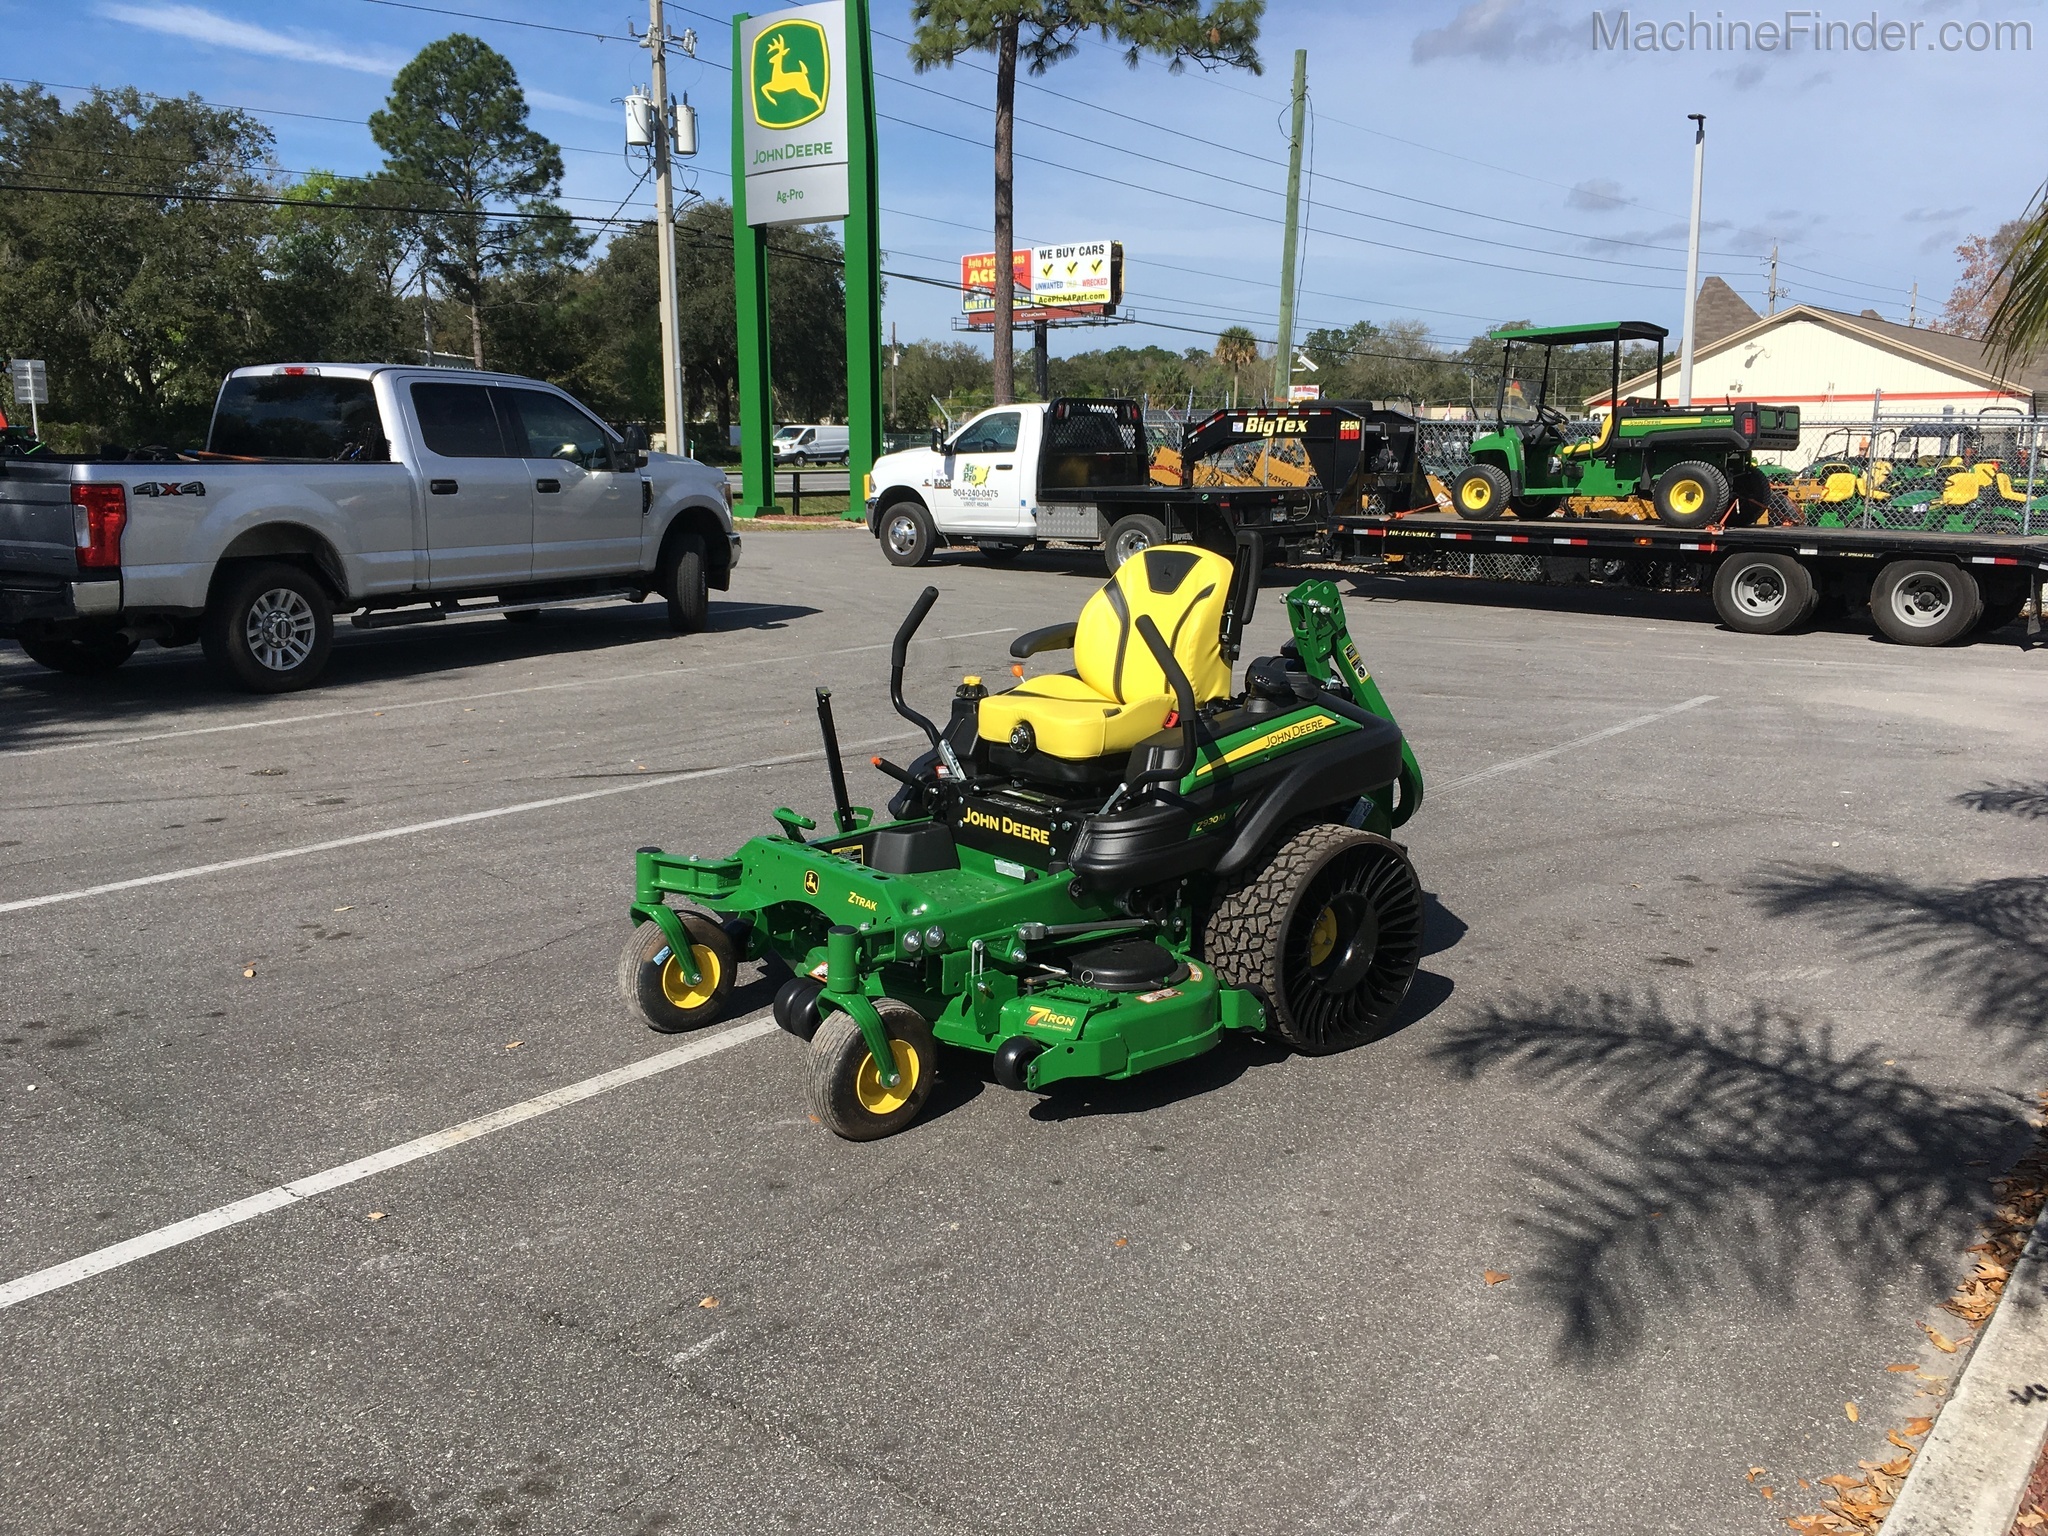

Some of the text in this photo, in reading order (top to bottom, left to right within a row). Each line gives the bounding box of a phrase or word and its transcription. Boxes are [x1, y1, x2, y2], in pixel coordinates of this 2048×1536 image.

[753, 142, 833, 165] JOHN DEERE
[776, 188, 804, 204] Ag-Pro
[1039, 244, 1105, 260] WE BUY CARS
[968, 258, 982, 269] Auto
[983, 257, 996, 267] Part
[1035, 281, 1064, 290] UNWANTED
[1082, 277, 1108, 287] WRECKED
[1245, 417, 1308, 437] BigTex
[1340, 430, 1360, 440] HD
[1267, 472, 1293, 487] RAYCO
[953, 488, 999, 498] 904-240-0475
[1388, 529, 1436, 538] HI-TENSILE
[1265, 718, 1324, 748] JOHN DEERE
[963, 807, 1050, 845] JOHN DEERE
[1195, 812, 1226, 832] Z930M
[848, 891, 878, 911] ZTRAK
